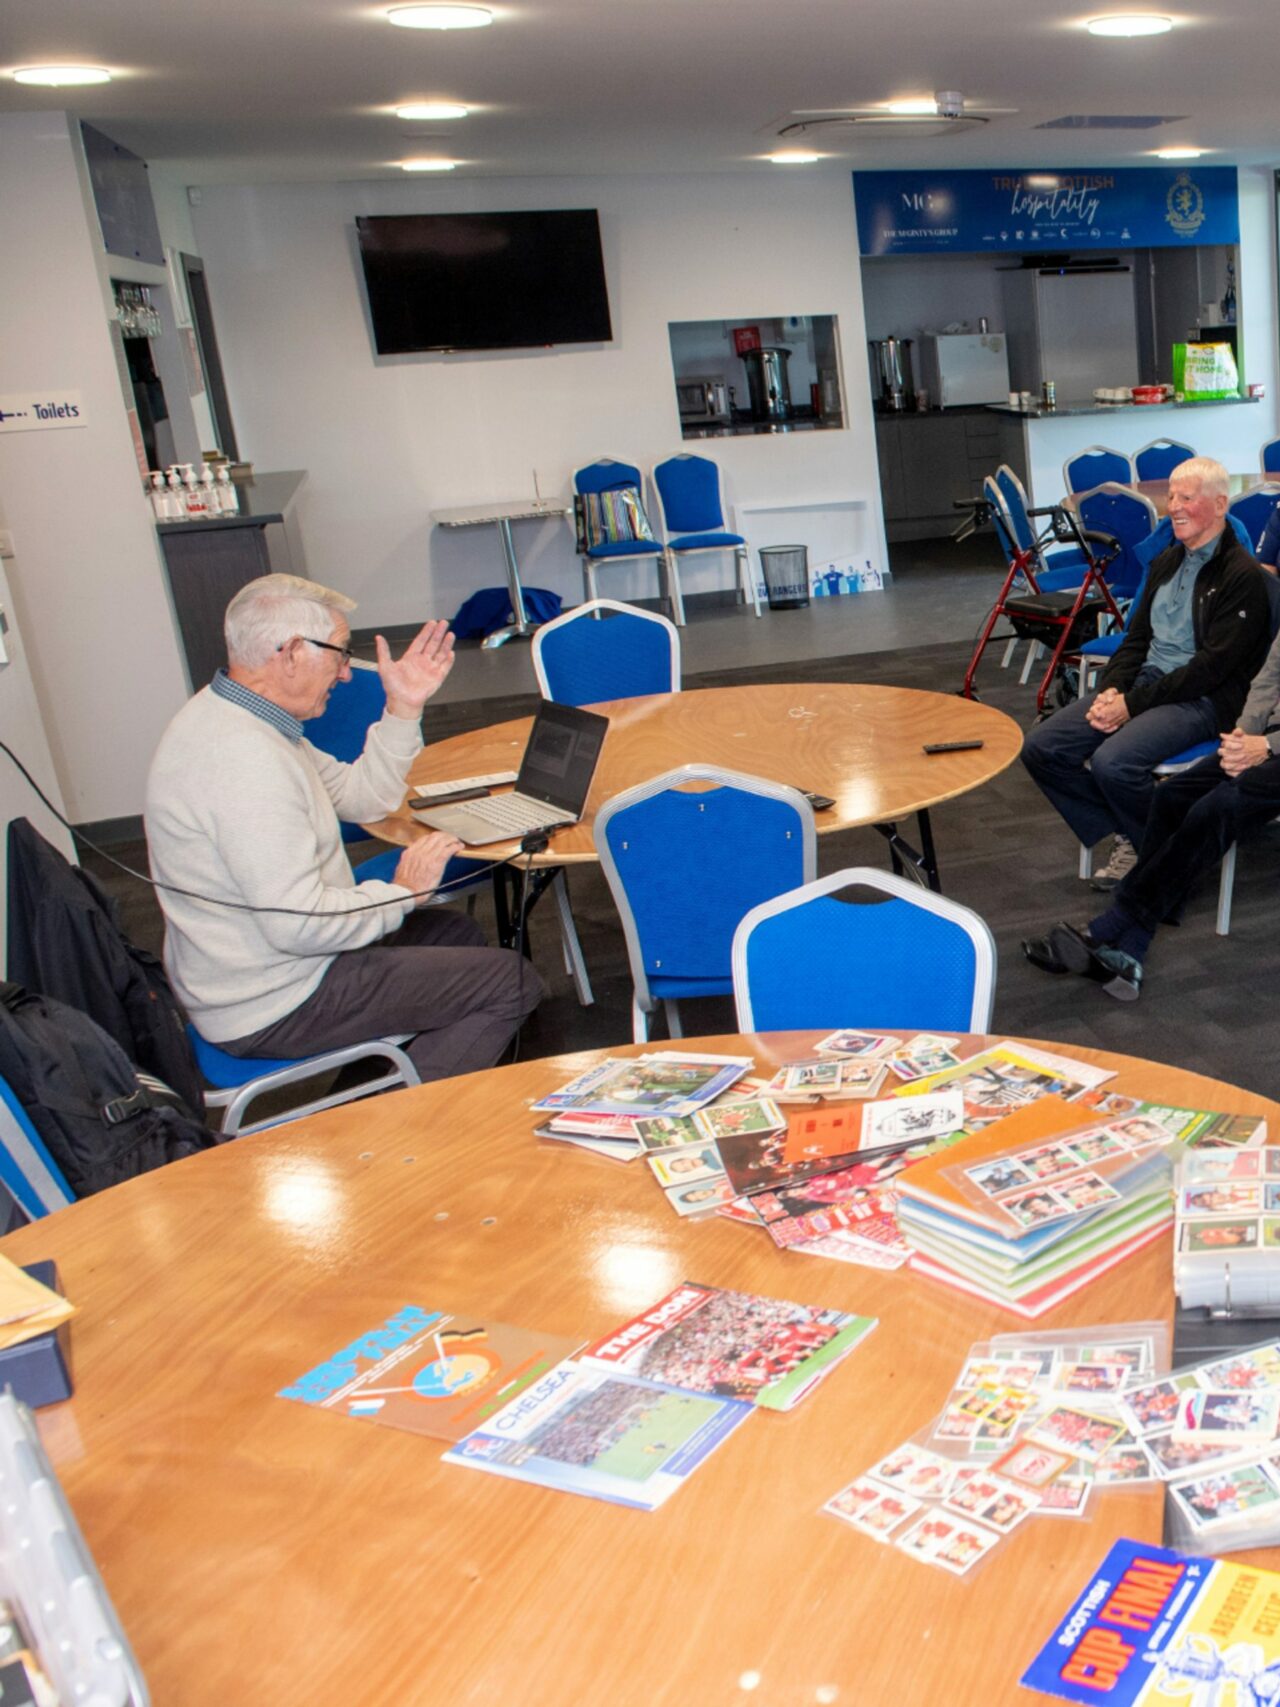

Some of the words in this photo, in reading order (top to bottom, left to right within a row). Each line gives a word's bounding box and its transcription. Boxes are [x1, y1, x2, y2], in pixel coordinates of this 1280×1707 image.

[1011, 183, 1101, 225] hospitality
[32, 402, 80, 420] Toilets
[595, 1322, 653, 1358] THE
[643, 1290, 702, 1325] DON
[495, 1369, 576, 1431] CHELSEA
[1057, 1580, 1112, 1647] SCOTTISH
[1060, 1627, 1135, 1691] CUP
[1098, 1558, 1187, 1631] FINAL
[1209, 1573, 1259, 1638] ABERDEEN
